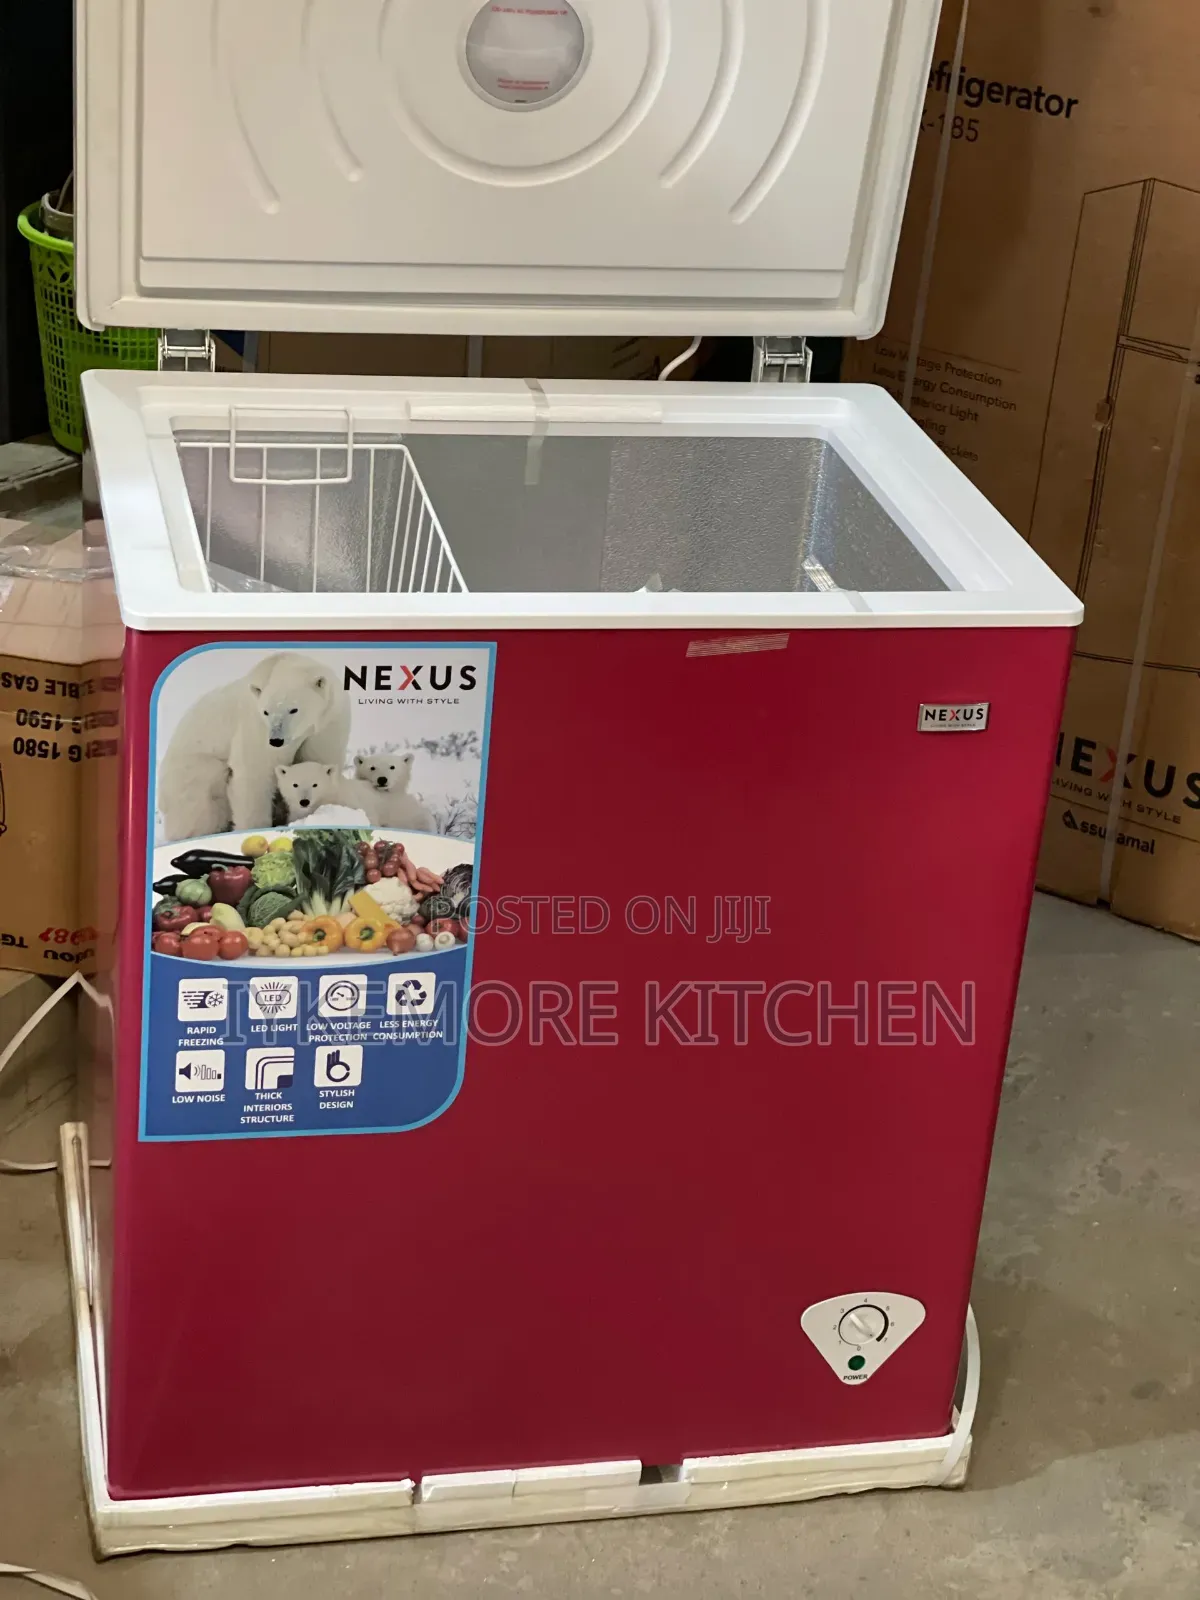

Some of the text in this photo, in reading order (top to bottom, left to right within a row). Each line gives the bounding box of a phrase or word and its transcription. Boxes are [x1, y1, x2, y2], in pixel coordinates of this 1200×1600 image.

[876, 343, 1003, 388] Low Vtage Protection
[897, 371, 937, 393] Eergy
[939, 381, 1017, 412] Consumption
[909, 394, 980, 422] nterior Light
[0, 671, 39, 692] GAS
[343, 664, 477, 692] NEXUS
[358, 697, 460, 705] LIVING WITH STYLE
[15, 707, 64, 732] 1590
[924, 707, 985, 721] NEXUS
[12, 736, 61, 760] 1580
[1096, 790, 1133, 809] WH
[1136, 803, 1182, 825] STYLE
[1061, 808, 1156, 856] Assuamal
[264, 994, 282, 1002] LED
[250, 1023, 298, 1033] LED LIGHT
[306, 1020, 372, 1031] LOW VOLTAGE
[379, 1019, 439, 1029] LESS ENERGY
[186, 1026, 217, 1035] RAPID
[372, 1030, 444, 1041] CONSUMPTION
[178, 1037, 225, 1047] FREEZING
[308, 1032, 368, 1043] PROTECTION
[171, 1093, 226, 1105] LOW NOISE
[254, 1091, 283, 1101] THICK
[318, 1088, 356, 1099] STYLISH
[243, 1102, 293, 1113] INTERIORS
[319, 1100, 355, 1110] DESIGN
[239, 1114, 295, 1125] STRUCTURE
[842, 1373, 869, 1381] POWER
